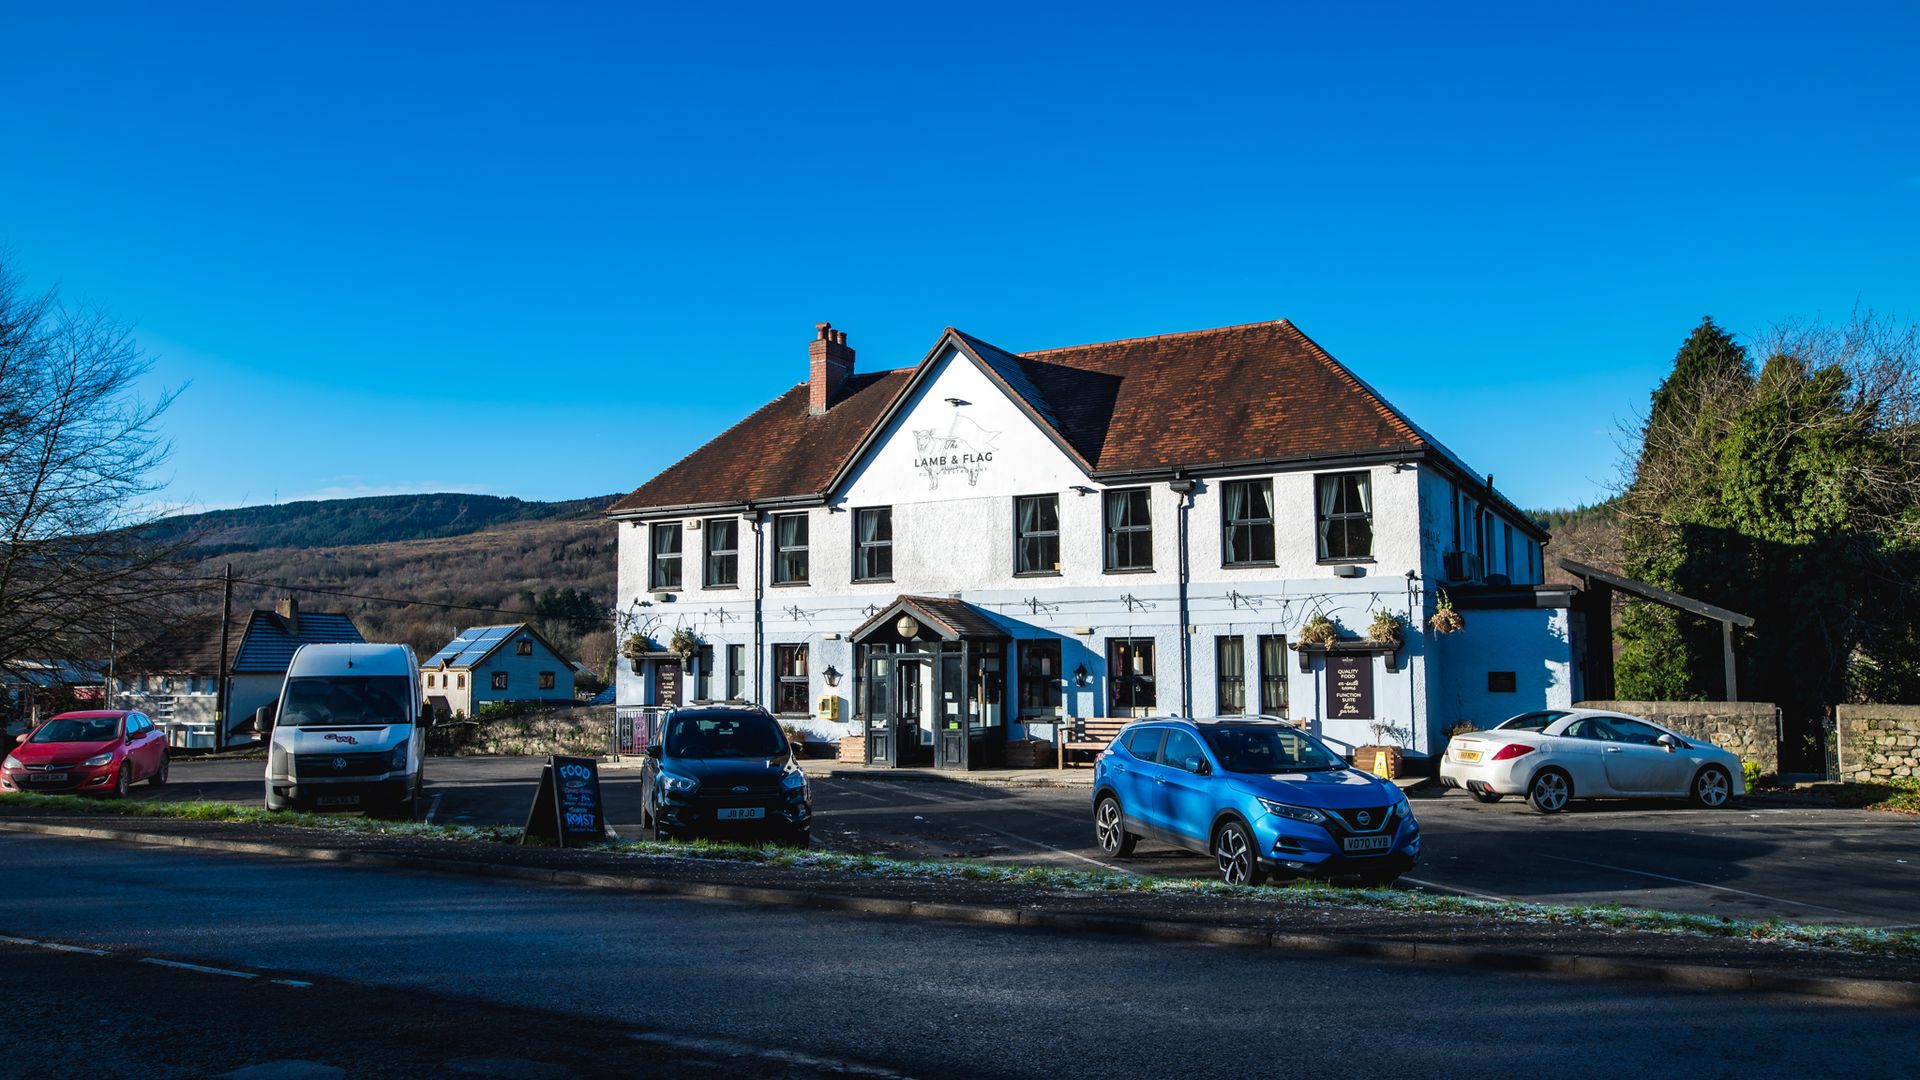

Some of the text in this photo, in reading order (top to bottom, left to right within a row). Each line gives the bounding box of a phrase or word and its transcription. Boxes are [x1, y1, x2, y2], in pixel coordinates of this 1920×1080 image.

[944, 439, 958, 450] The
[914, 452, 993, 468] LAMB & FLAG
[560, 764, 591, 780] FOOD
[565, 812, 596, 826] ROAST
[1348, 838, 1371, 849] VO70
